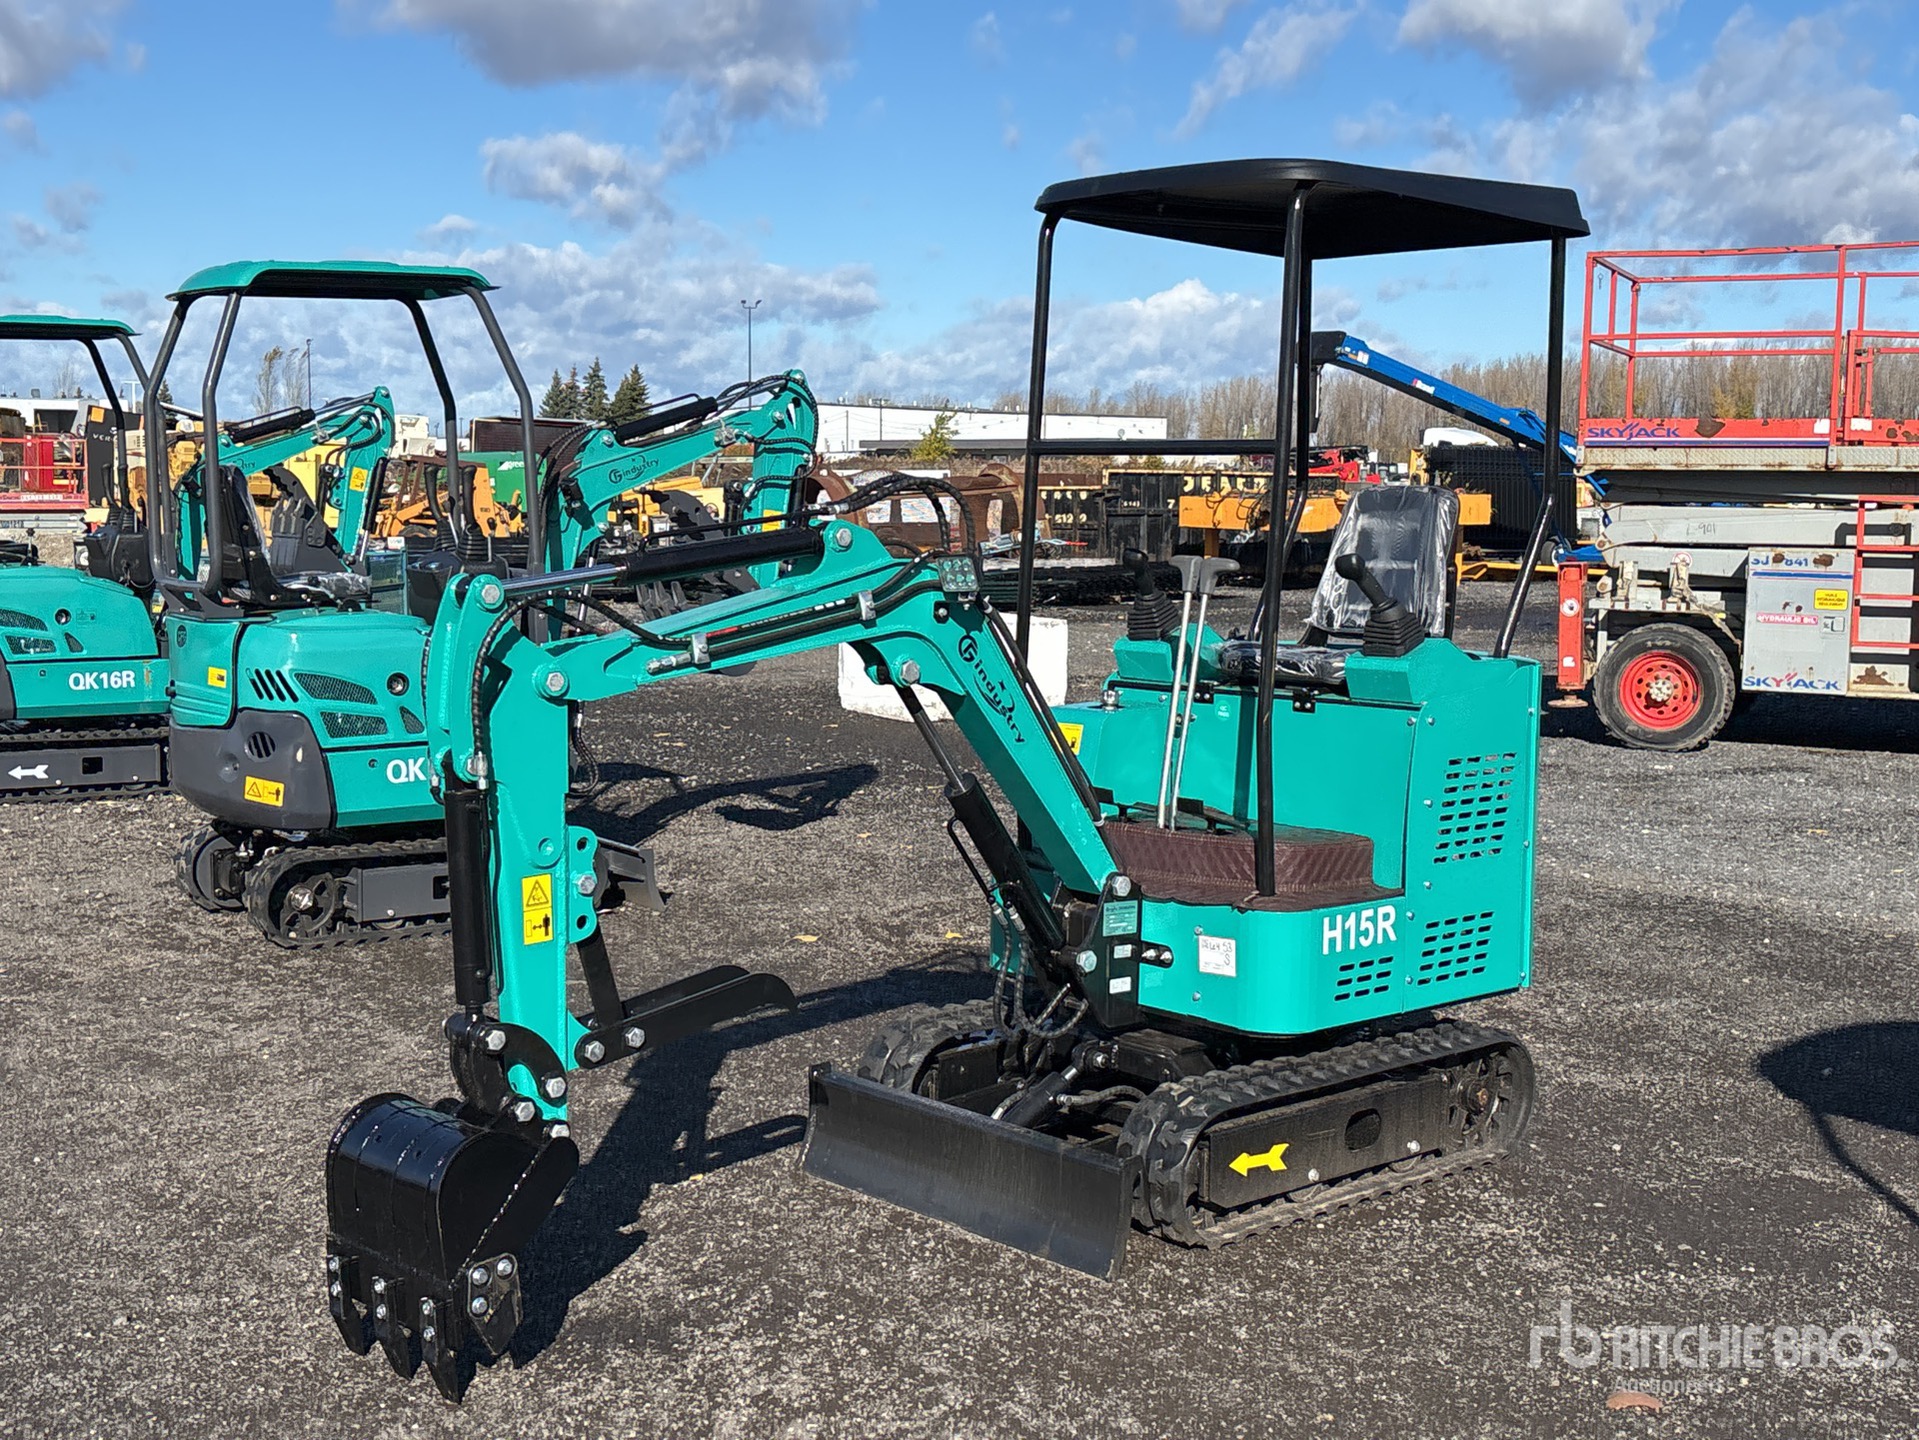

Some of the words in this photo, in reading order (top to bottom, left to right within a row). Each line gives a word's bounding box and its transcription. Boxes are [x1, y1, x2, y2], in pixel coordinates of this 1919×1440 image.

[1587, 422, 1680, 440] SKYJACK
[69, 670, 135, 690] QK16R
[1322, 905, 1397, 955] H15R
